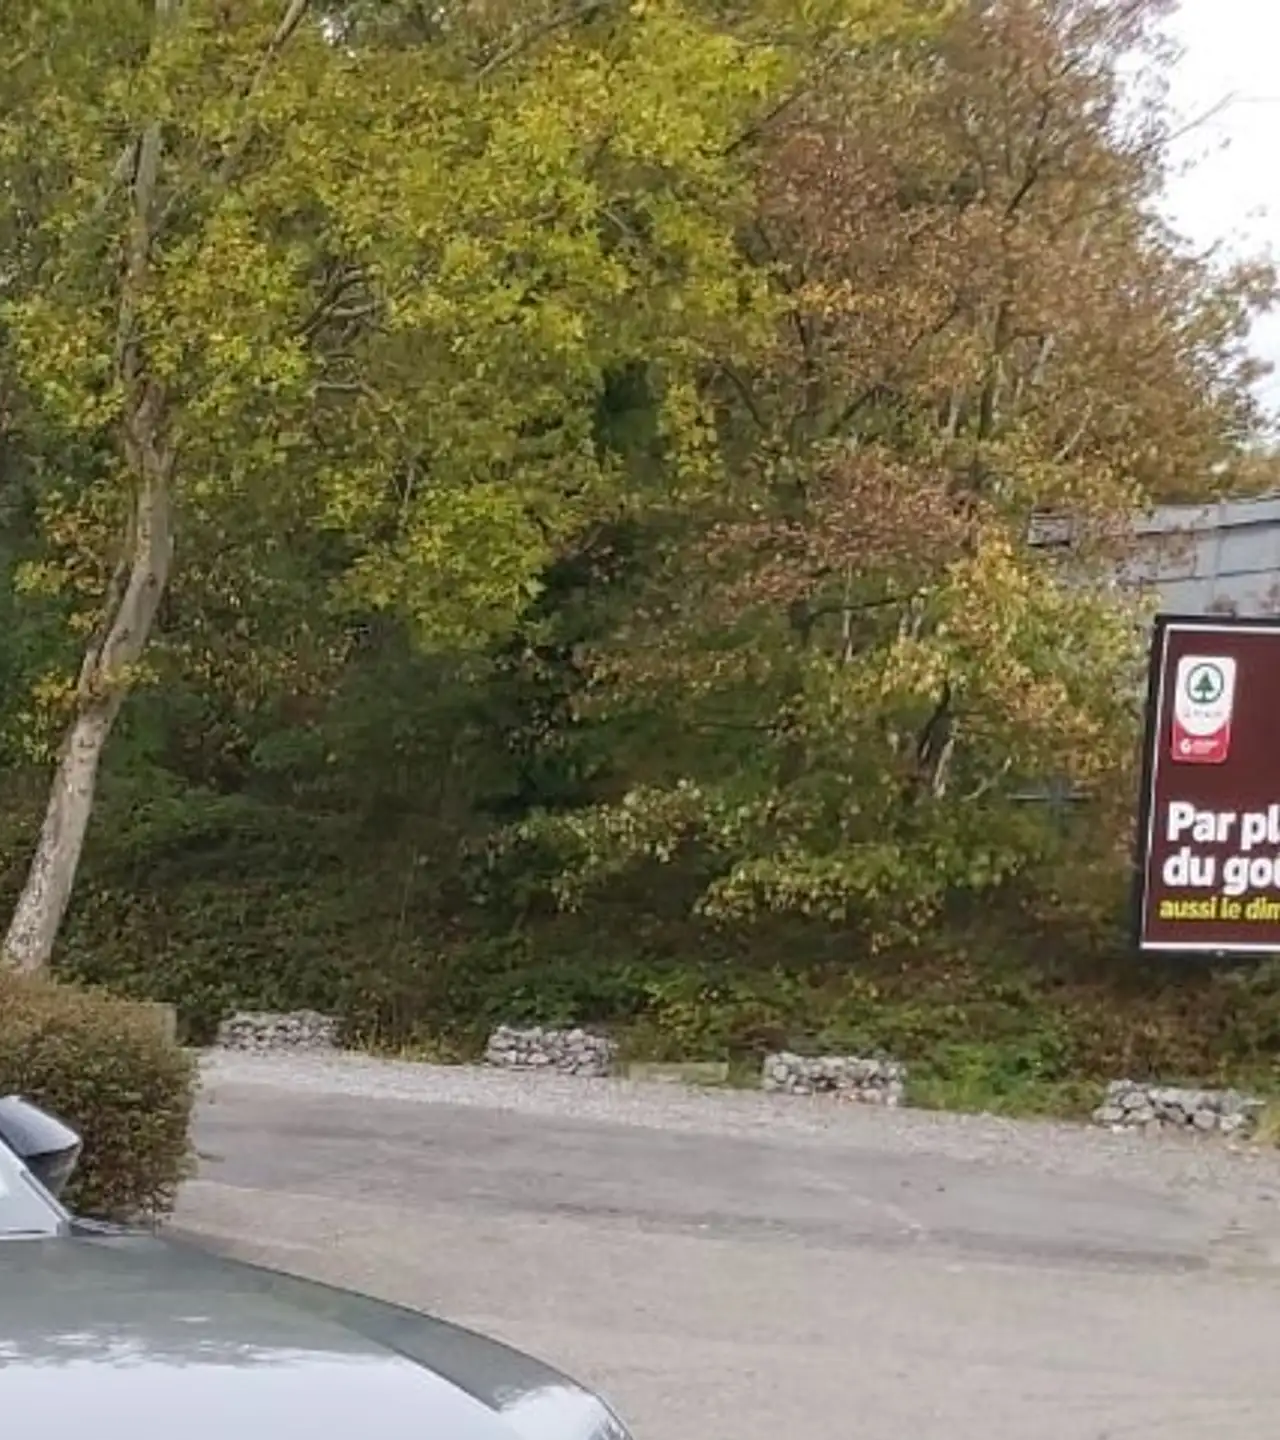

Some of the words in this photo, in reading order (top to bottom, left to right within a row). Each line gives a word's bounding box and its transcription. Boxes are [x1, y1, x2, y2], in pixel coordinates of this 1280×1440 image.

[1167, 801, 1237, 842] Par
[1162, 846, 1216, 887] du
[1159, 896, 1218, 920] aussi
[1221, 897, 1242, 920] le
